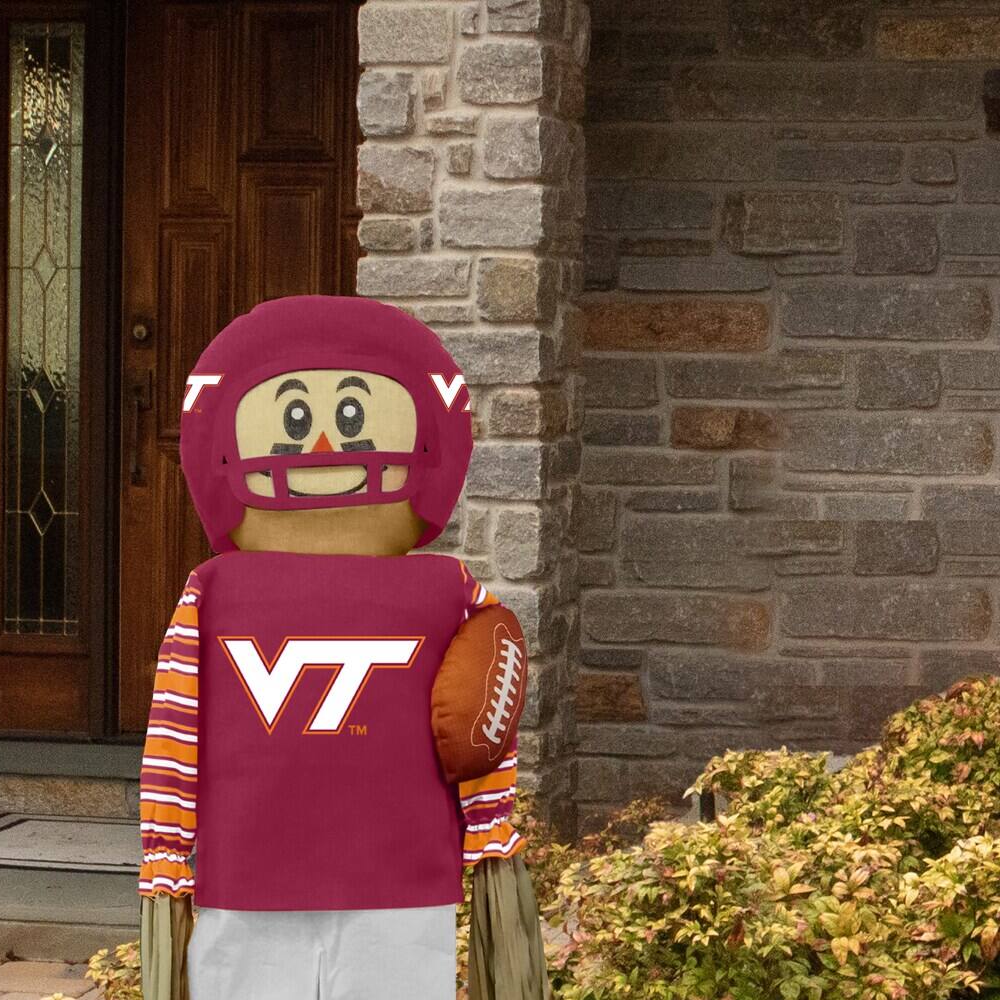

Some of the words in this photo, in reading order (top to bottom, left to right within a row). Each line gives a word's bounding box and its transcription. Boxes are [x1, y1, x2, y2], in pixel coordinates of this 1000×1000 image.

[182, 373, 225, 413] T
[217, 636, 426, 735] VT
[348, 724, 367, 736] TM
